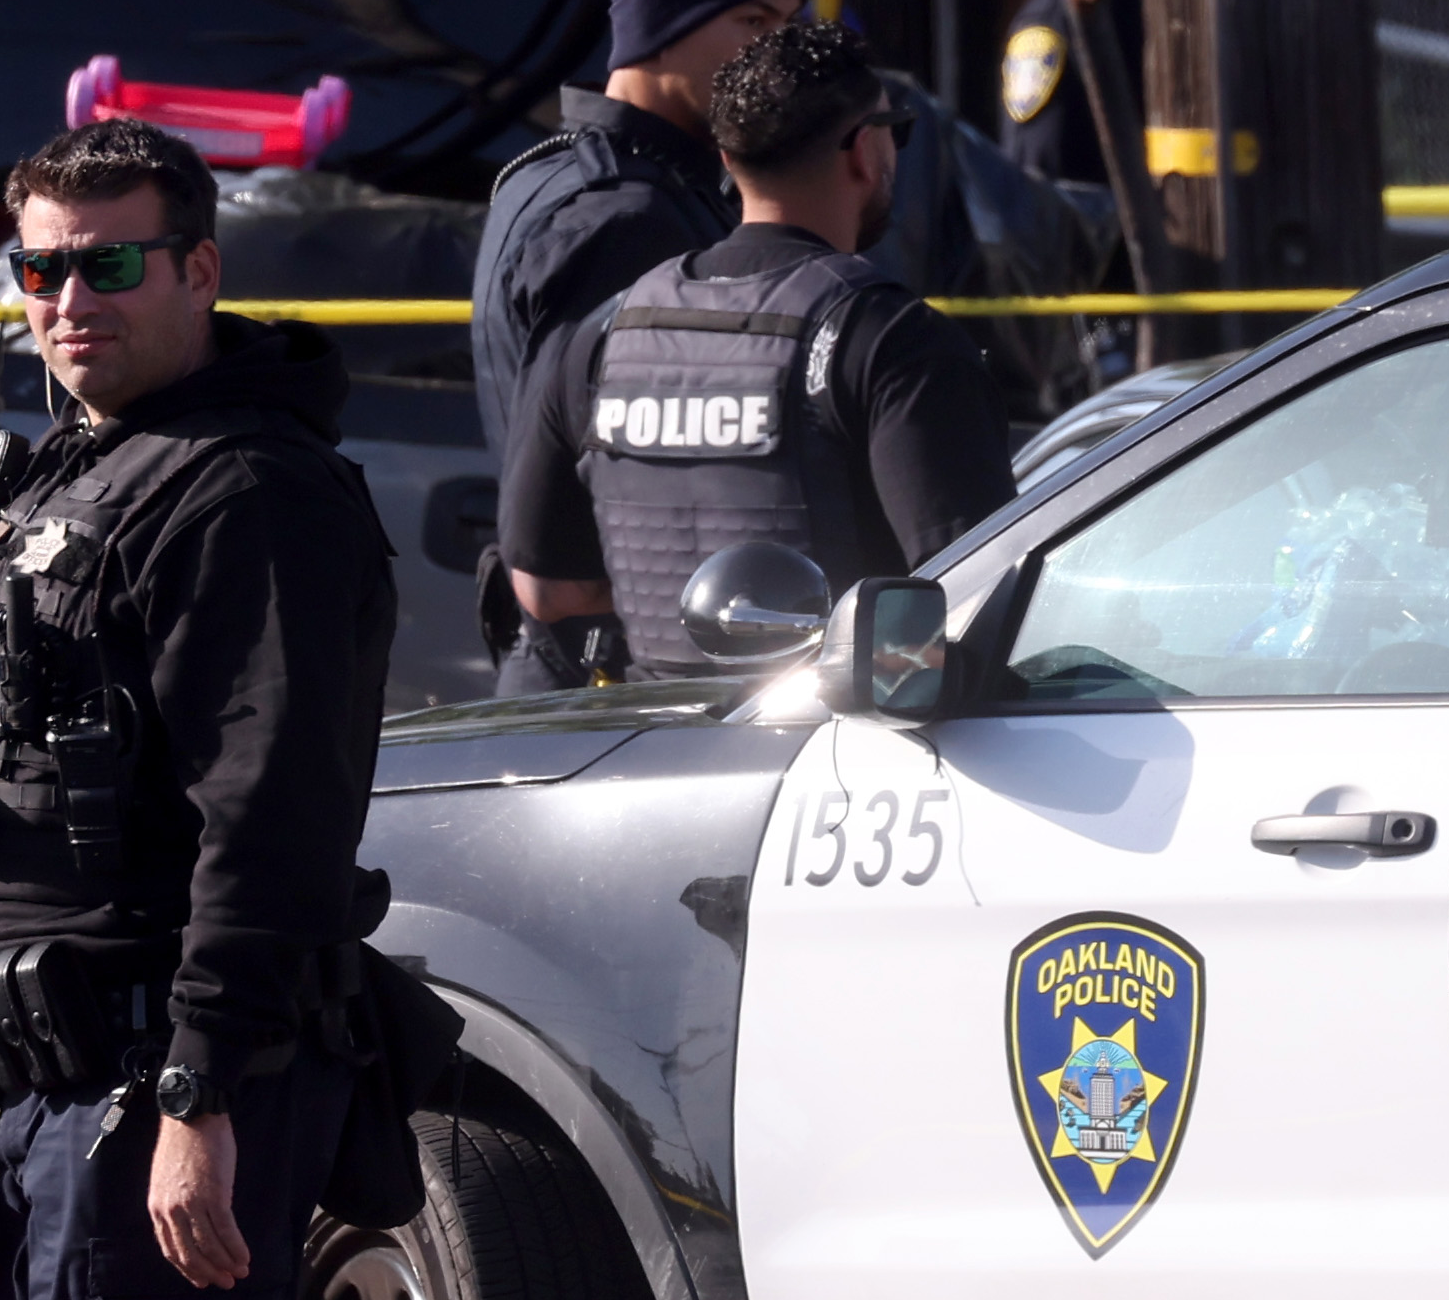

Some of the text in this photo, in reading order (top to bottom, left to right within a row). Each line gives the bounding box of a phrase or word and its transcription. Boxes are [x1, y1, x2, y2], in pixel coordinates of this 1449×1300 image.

[596, 395, 770, 447] POLICE
[784, 789, 950, 888] 1535
[1036, 941, 1176, 999] OAKLAND
[1054, 973, 1157, 1022] POLICE
